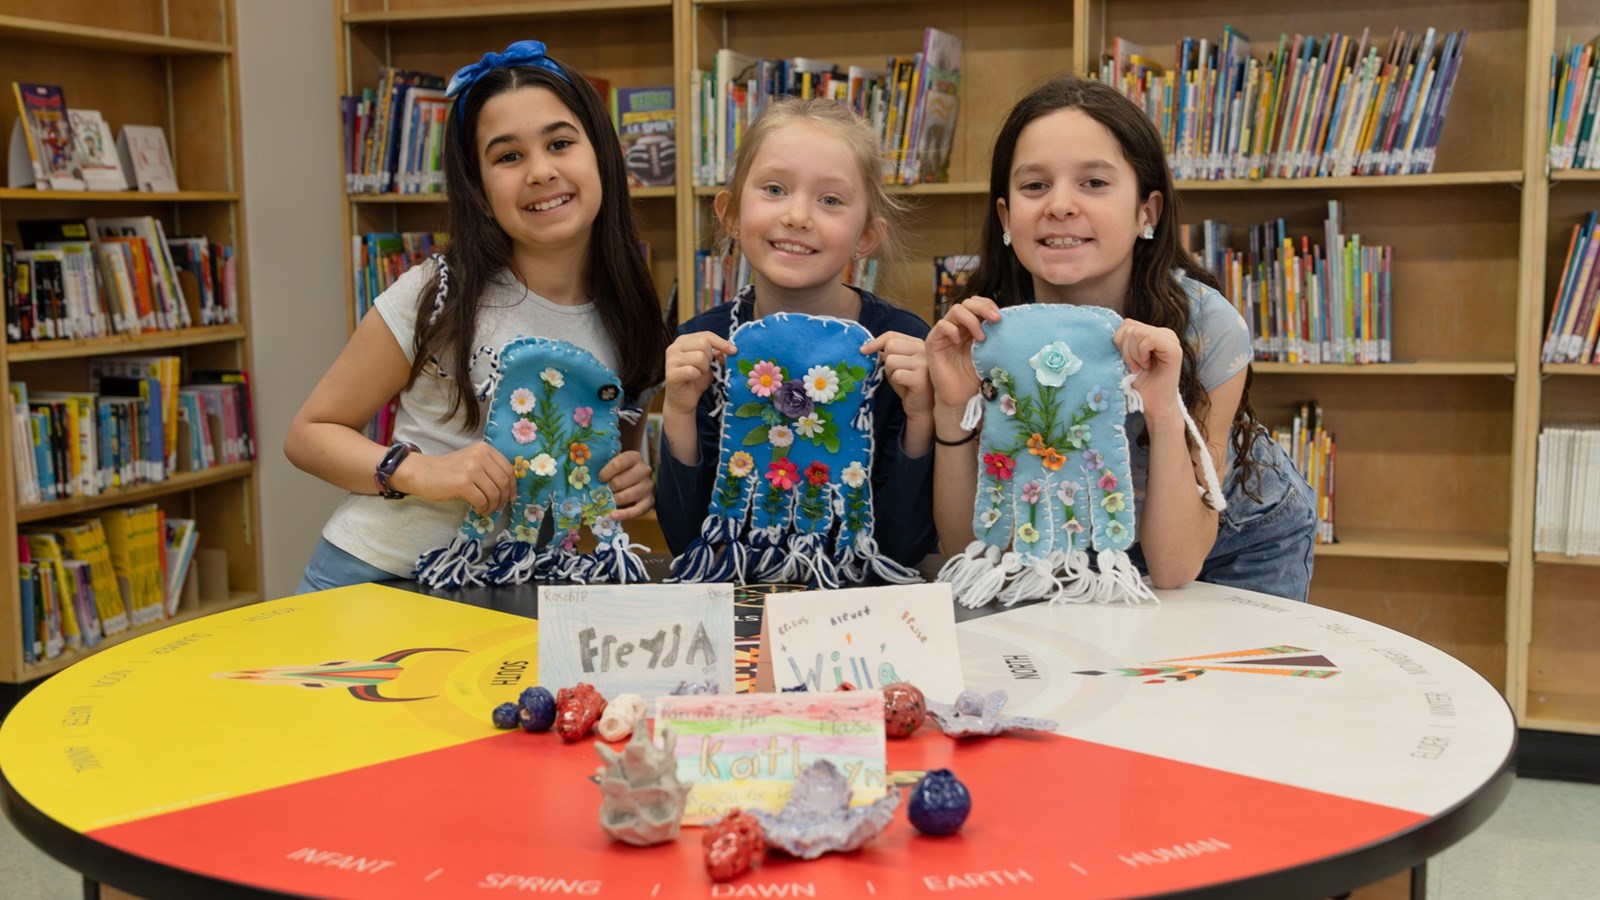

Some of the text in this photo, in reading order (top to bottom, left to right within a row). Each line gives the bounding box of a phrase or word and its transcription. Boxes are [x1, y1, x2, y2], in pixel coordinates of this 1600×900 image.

[490, 660, 529, 686] SOUTH
[788, 651, 903, 692] Willa
[1003, 655, 1041, 680] NORTH
[1423, 692, 1456, 716] WINTER
[1410, 736, 1449, 759] ELDER
[700, 735, 885, 787] Kathyn
[288, 838, 1229, 898] INFANT SPRING DAWN EARTH HUMAN
